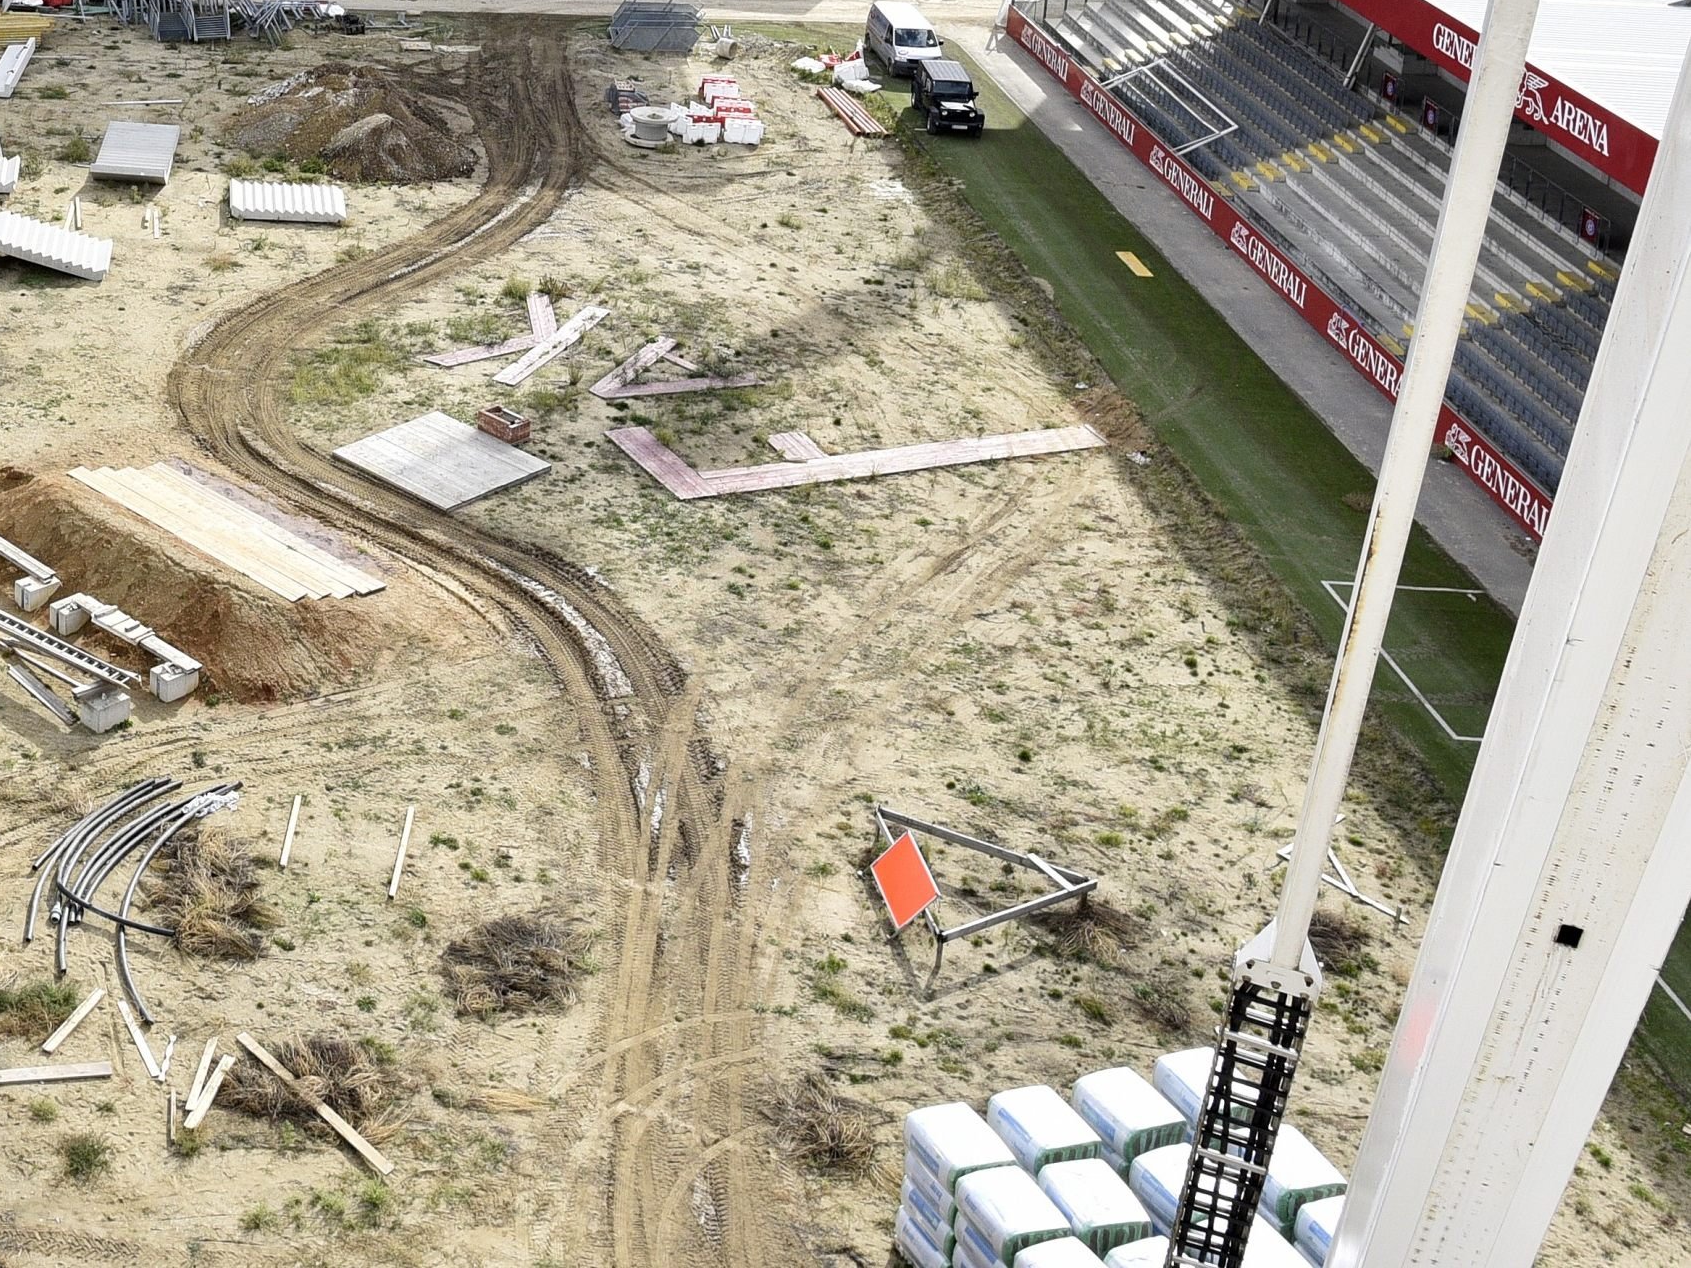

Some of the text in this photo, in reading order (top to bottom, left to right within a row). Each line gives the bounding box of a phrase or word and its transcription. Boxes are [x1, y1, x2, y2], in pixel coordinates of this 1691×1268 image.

[1030, 34, 1069, 83] GENERALI
[1091, 90, 1136, 147] GENERALI
[1550, 95, 1610, 157] ARENA
[1163, 157, 1216, 221] GENERALI
[1247, 235, 1308, 309] GENERALI
